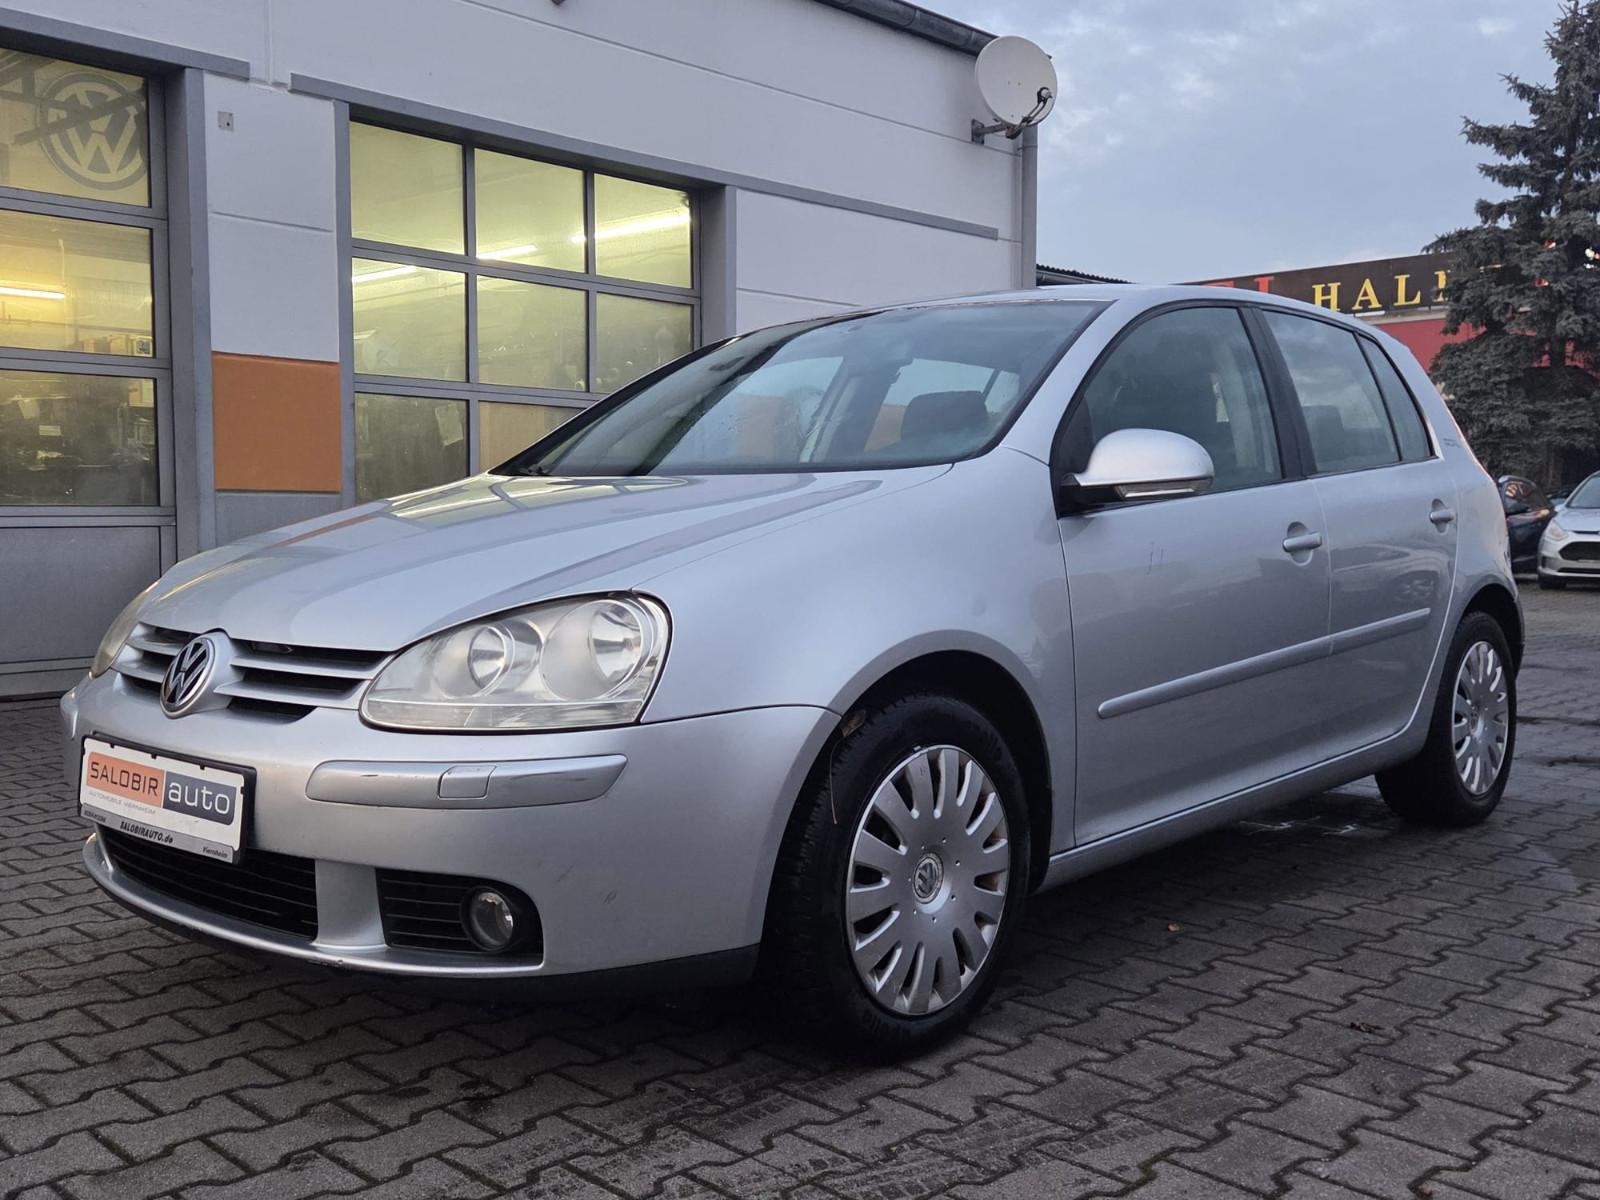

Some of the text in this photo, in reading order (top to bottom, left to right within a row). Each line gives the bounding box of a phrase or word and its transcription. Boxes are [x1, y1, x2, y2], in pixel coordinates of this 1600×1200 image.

[90, 761, 230, 815] SALOBIR auto
[119, 820, 174, 844] SALOBIRAUTO.de
